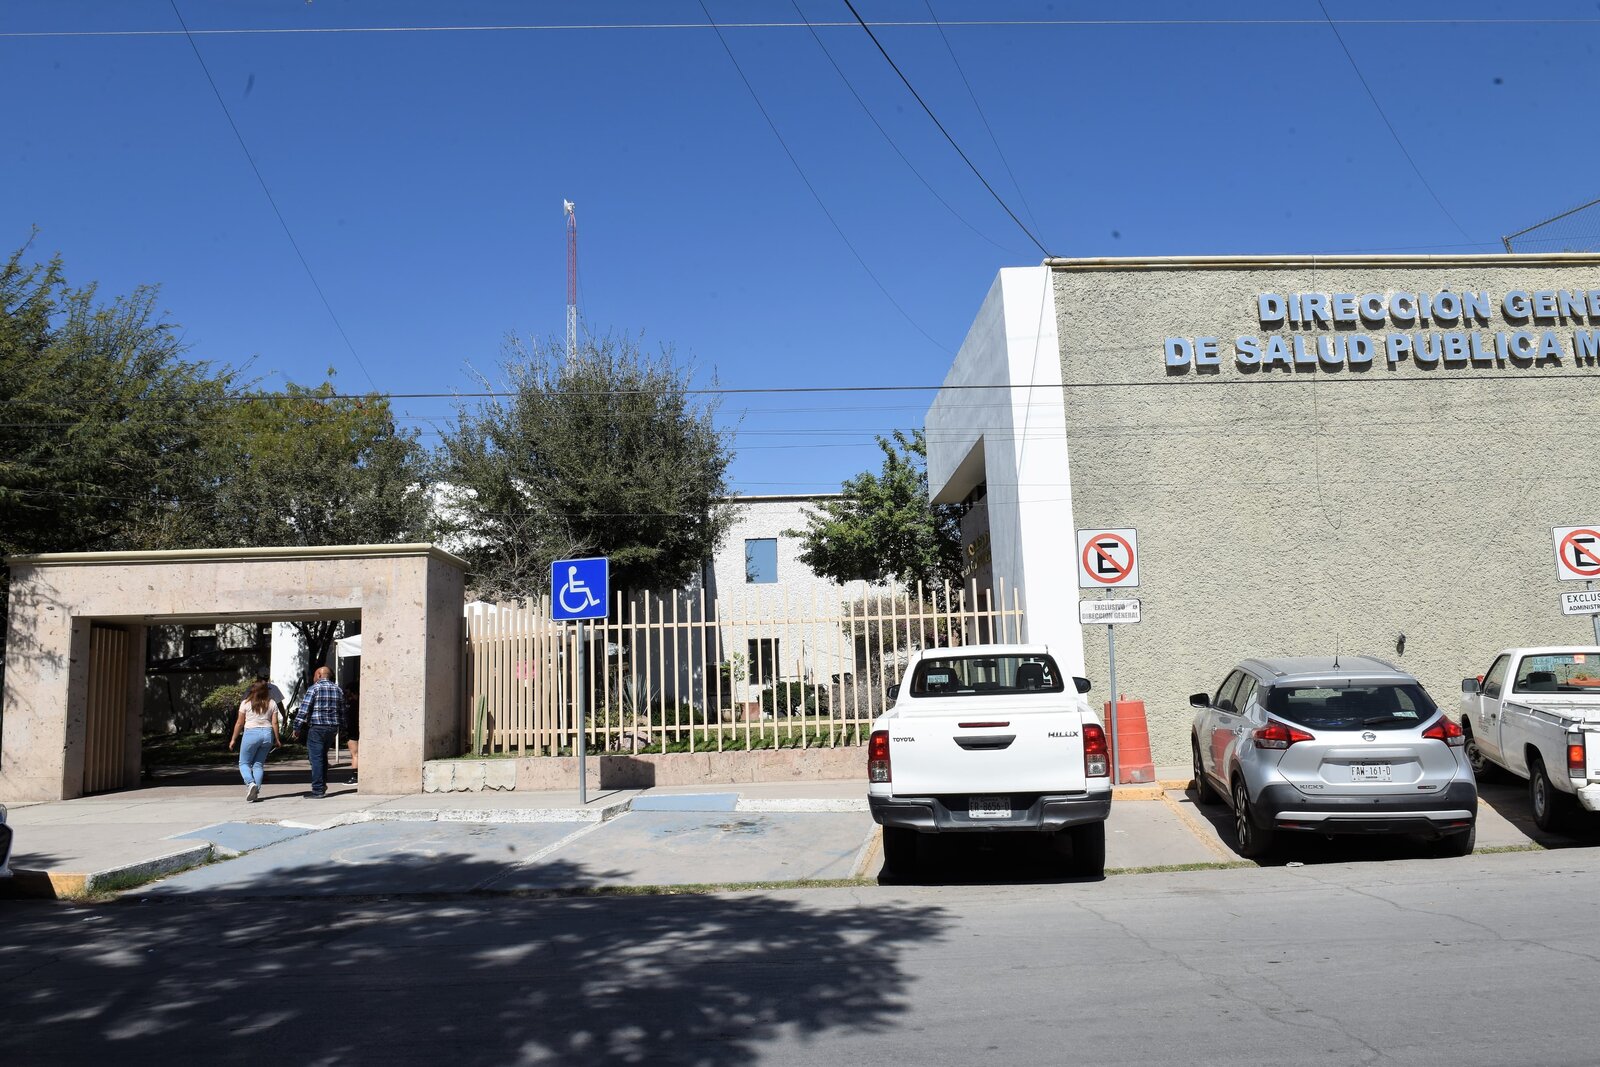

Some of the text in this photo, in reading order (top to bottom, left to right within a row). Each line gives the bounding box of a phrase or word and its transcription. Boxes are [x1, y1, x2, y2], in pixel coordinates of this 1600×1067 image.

[1258, 284, 1492, 322] DIRECCIÓN
[1164, 328, 1600, 367] DE SALUD PUBLICA M
